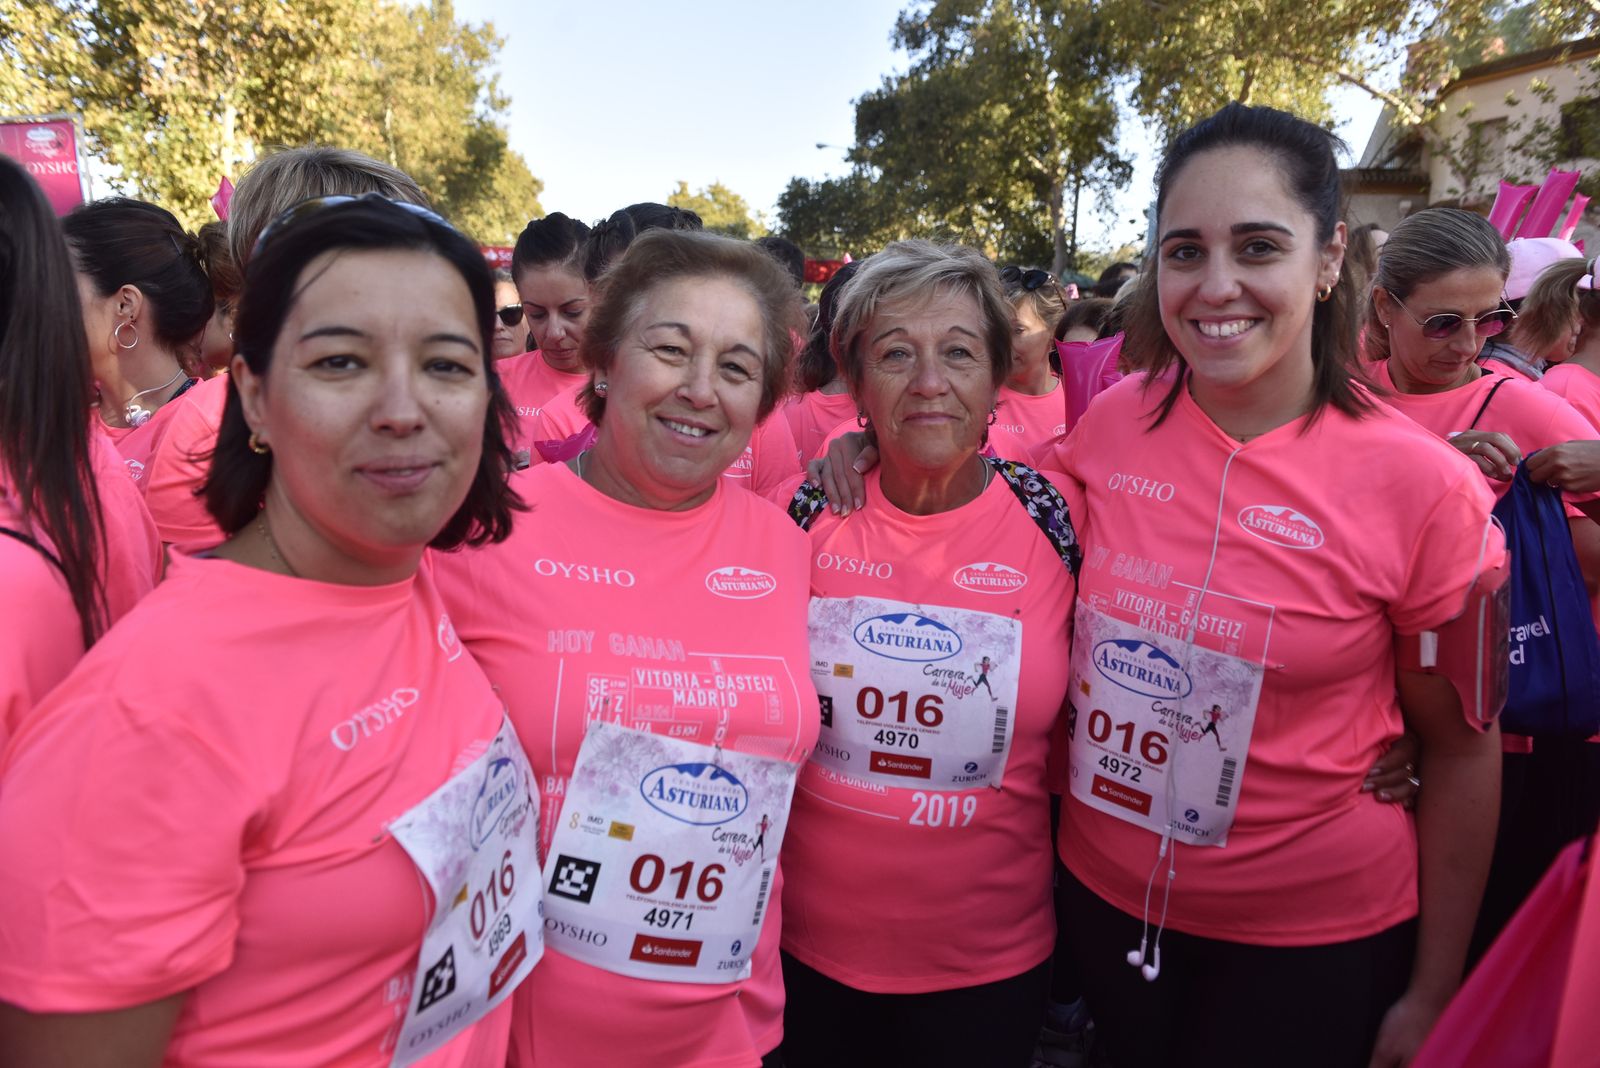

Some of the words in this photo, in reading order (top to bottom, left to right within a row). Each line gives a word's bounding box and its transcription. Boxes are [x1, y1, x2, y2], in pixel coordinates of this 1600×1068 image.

[1108, 473, 1175, 502] OYSHO
[1243, 511, 1315, 546] ASTURIANA
[534, 558, 636, 588] OYSHO
[817, 552, 893, 580] OYSHO
[959, 570, 1023, 587] ASTURIANA
[1110, 553, 1174, 589] GANAN
[711, 576, 772, 592] ASTURIANA
[1116, 590, 1166, 620] VITORIA
[861, 624, 953, 653] ASTURIANA
[1140, 615, 1186, 640] MADRI
[547, 630, 596, 654] HOY
[608, 632, 687, 662] GANAN
[636, 669, 700, 690] VITORIA
[715, 674, 777, 692] GASTEIZ
[923, 663, 965, 681] Carrera
[1097, 648, 1181, 693] ASTURIANA
[672, 688, 738, 708] MADRID
[931, 678, 940, 687] de
[945, 679, 976, 700] Mujer
[330, 687, 419, 752] OYSHO
[856, 686, 944, 728] 016
[1151, 701, 1193, 726] Carrera
[816, 741, 851, 762] YSHO
[874, 729, 919, 749] 4970
[1087, 709, 1169, 766] 016
[887, 760, 924, 772] Santander
[951, 773, 987, 783] ZURICH
[1098, 754, 1142, 783] 4972
[648, 776, 740, 813] ASTURIANA
[1108, 787, 1144, 806] Santander
[909, 791, 977, 828] 2019
[711, 826, 748, 844] Carrera
[629, 853, 726, 903] 016
[470, 849, 515, 941] 016
[544, 917, 608, 948] OYSHO
[643, 907, 694, 931] 4971
[489, 913, 512, 957] 4969
[652, 945, 692, 959] Santander
[717, 953, 746, 971] ZURICH
